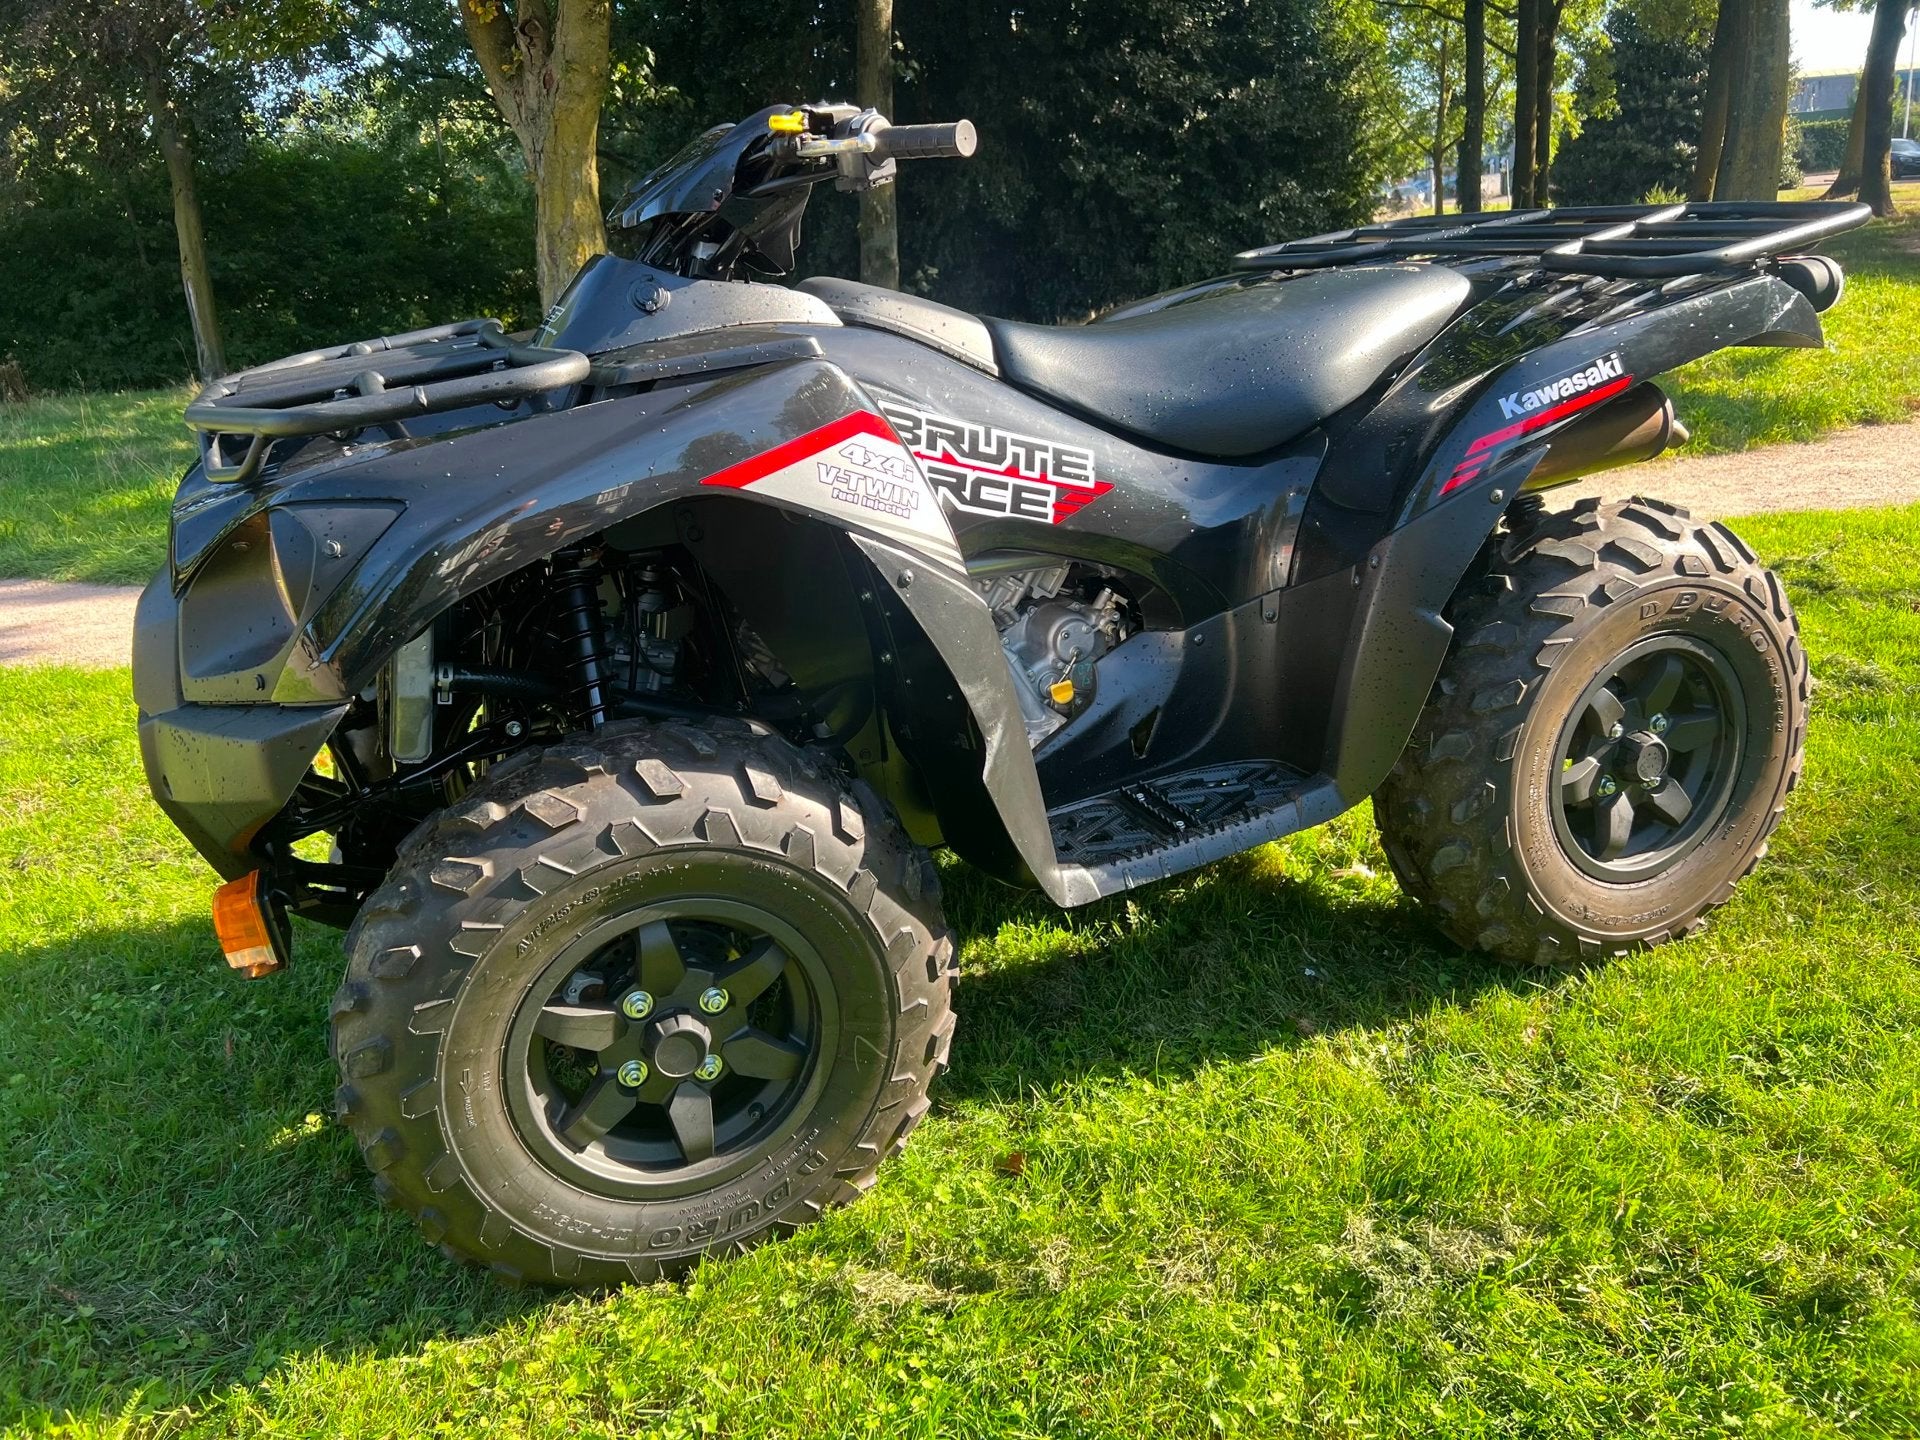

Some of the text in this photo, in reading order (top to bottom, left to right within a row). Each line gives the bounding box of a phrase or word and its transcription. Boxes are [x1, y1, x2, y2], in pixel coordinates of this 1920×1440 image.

[1498, 352, 1625, 420] Kawasaki
[878, 400, 1095, 488] BRUTE
[817, 462, 919, 510] V-TWIN
[831, 487, 910, 519] Fuel Injected
[924, 458, 1057, 523] RCE
[1668, 590, 1771, 654] DURO
[649, 1177, 794, 1249] DURO
